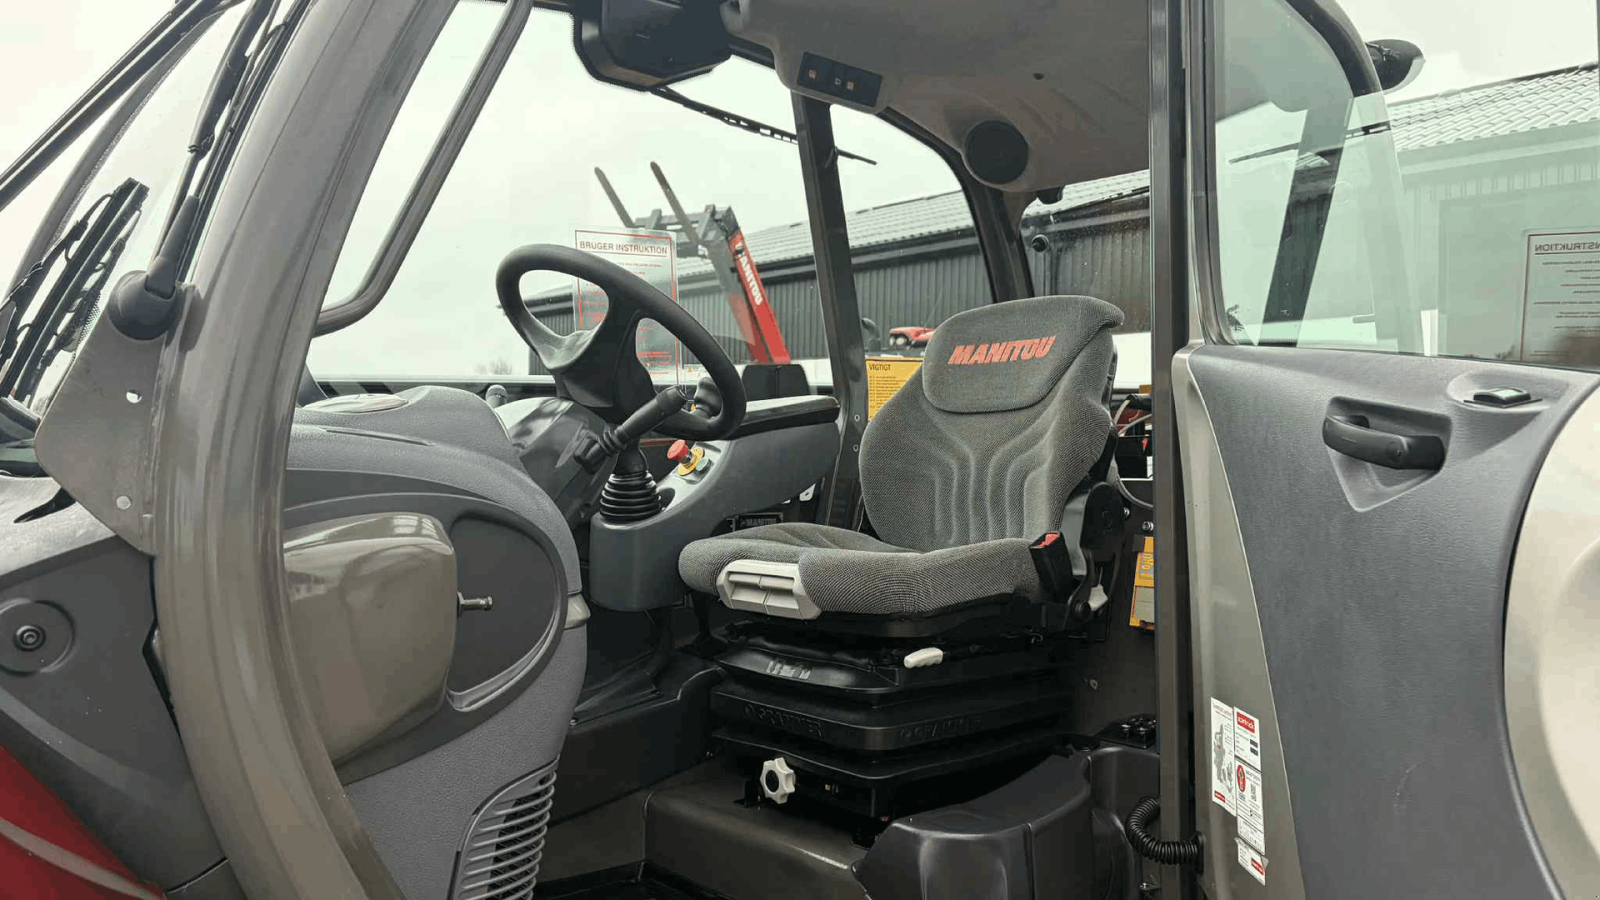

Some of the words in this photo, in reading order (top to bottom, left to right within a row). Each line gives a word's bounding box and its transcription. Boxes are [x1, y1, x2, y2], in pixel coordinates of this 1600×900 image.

[580, 240, 614, 251] BRUGER
[615, 244, 668, 255] INSTRUKTION
[948, 335, 1057, 365] MANITOU
[868, 363, 891, 371] VIGTIGT
